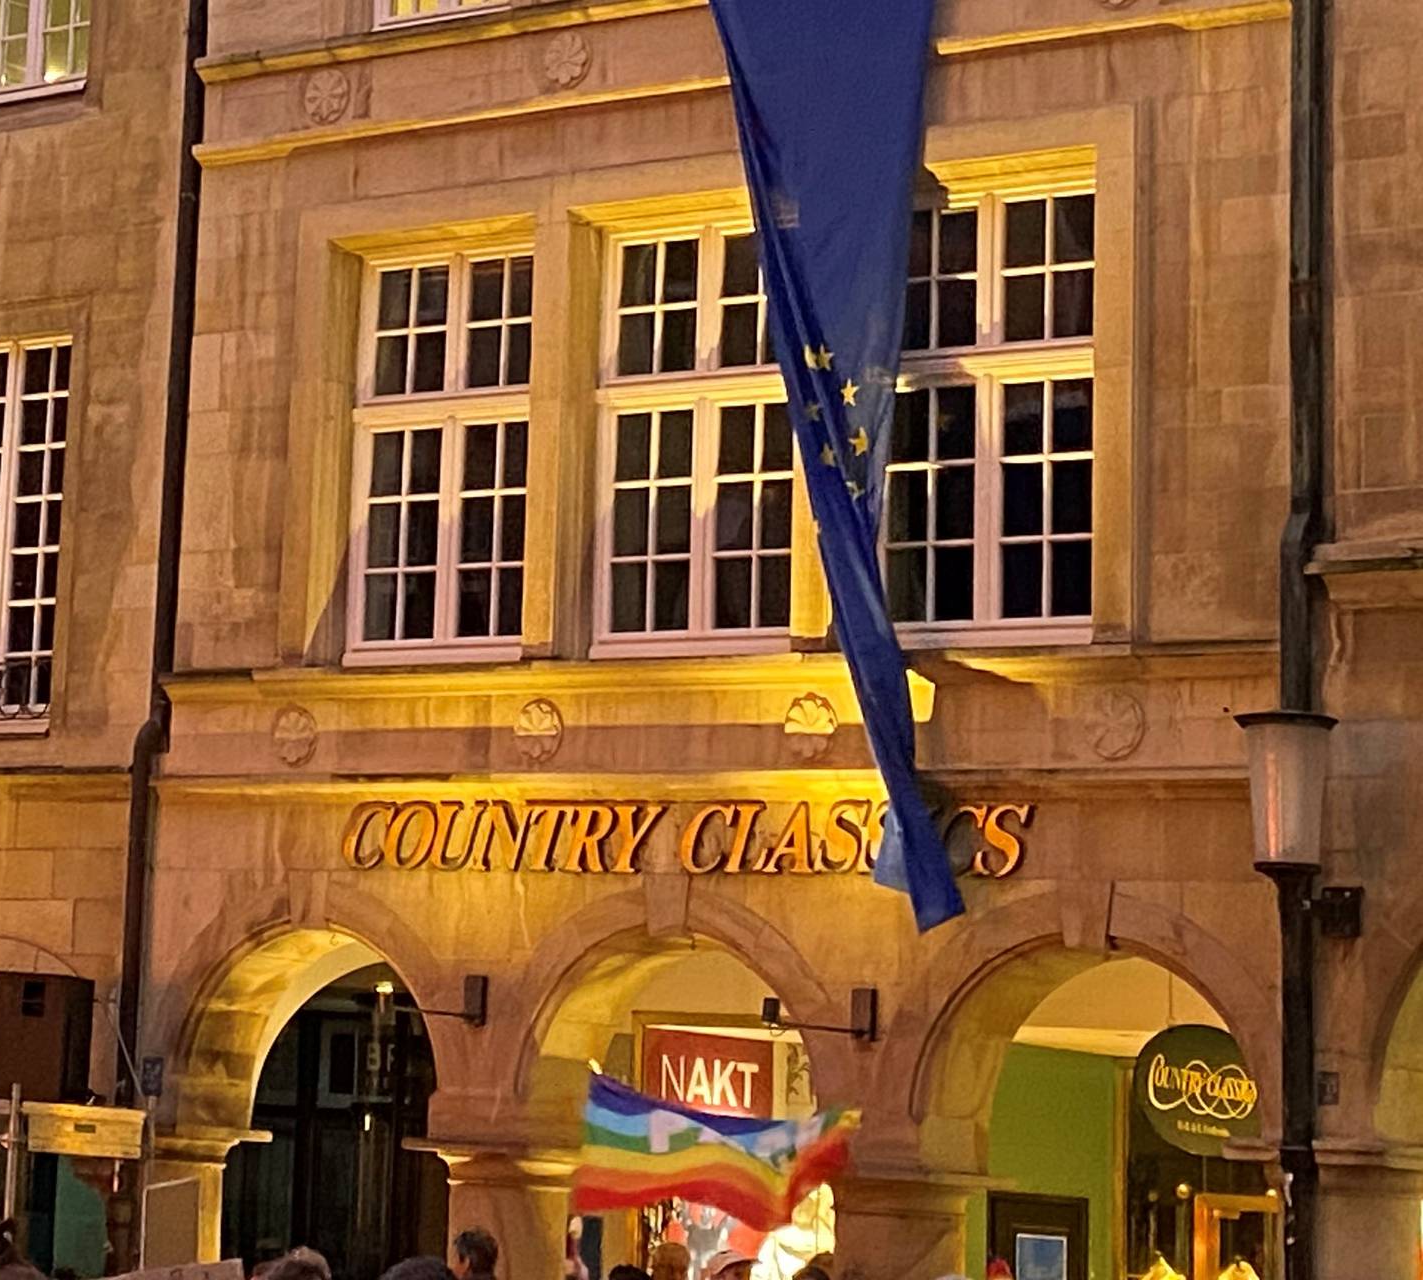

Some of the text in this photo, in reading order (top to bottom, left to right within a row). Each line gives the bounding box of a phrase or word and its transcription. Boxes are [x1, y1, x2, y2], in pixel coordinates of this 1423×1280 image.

[342, 800, 1036, 878] COUNTRY CLASSCS
[660, 1053, 760, 1109] NAKT
